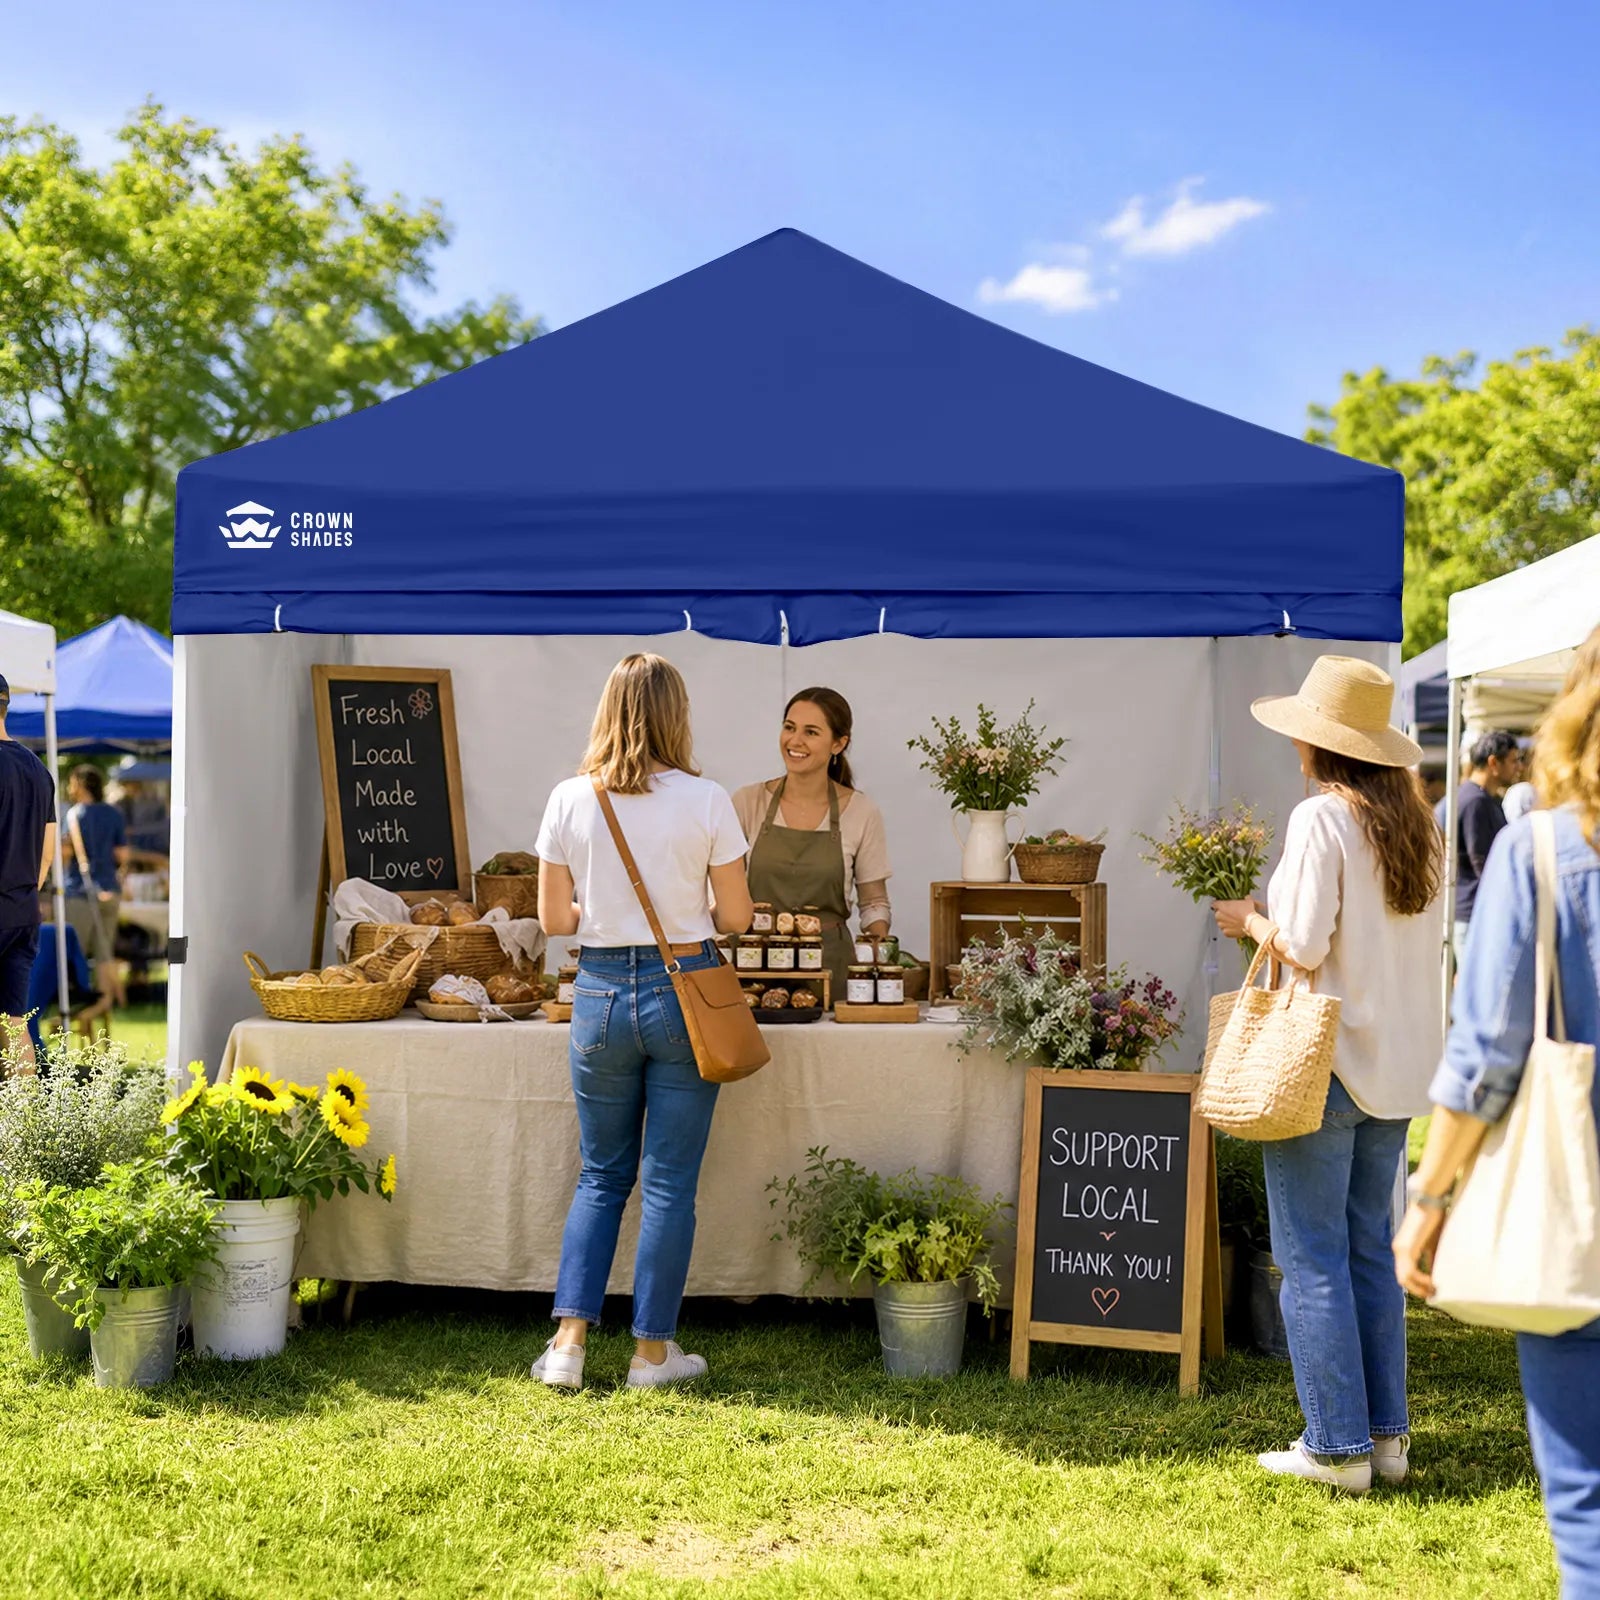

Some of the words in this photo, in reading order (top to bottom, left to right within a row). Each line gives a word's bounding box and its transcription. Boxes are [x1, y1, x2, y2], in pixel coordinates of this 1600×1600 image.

[290, 512, 353, 529] CROWN
[290, 531, 353, 547] SHADES
[340, 694, 405, 725] Fresh
[352, 739, 416, 765] Local
[356, 779, 417, 807] Made
[358, 819, 409, 843] with
[369, 853, 424, 880] Love
[1050, 1127, 1180, 1172] SUPPORT
[1062, 1182, 1159, 1224] LOCAL
[1045, 1248, 1114, 1277] THANK
[1124, 1254, 1171, 1283] YOU!
